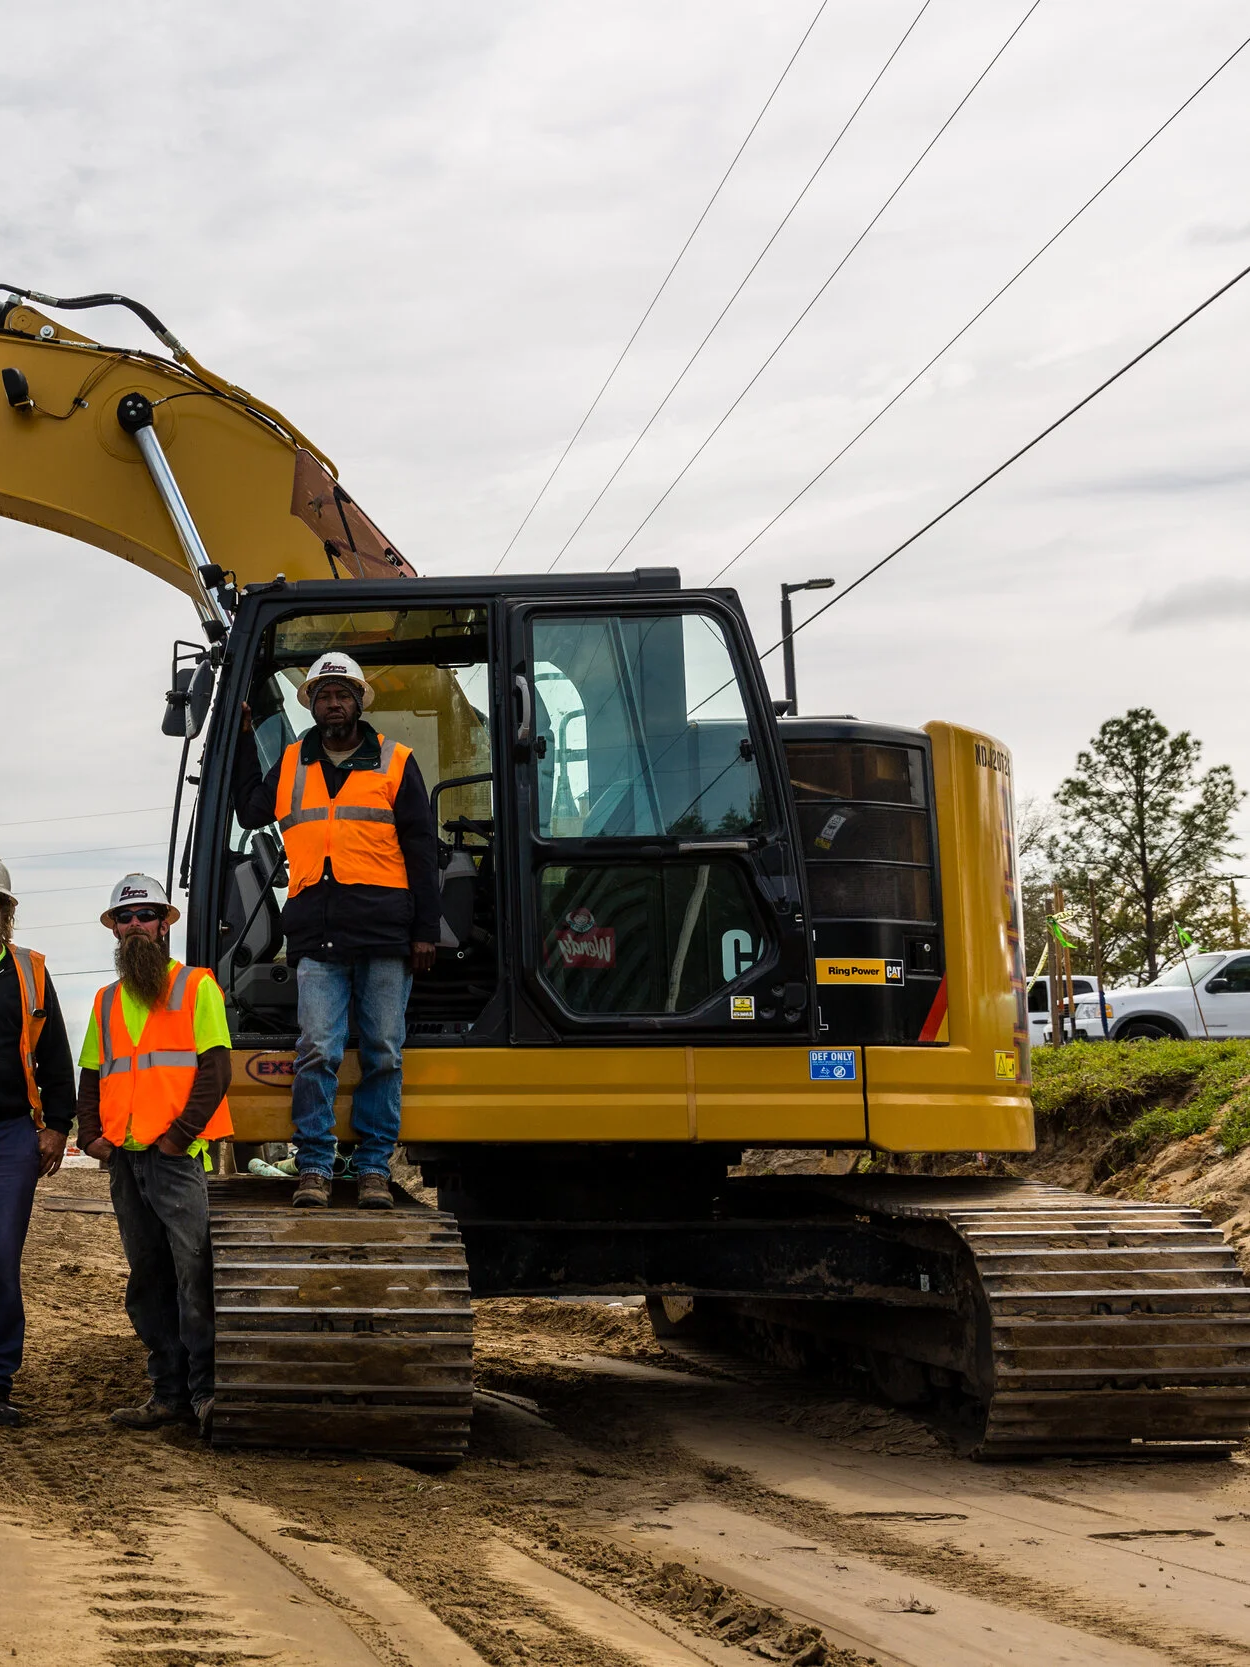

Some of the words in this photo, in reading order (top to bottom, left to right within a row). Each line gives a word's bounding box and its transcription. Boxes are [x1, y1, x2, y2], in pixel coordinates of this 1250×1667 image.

[828, 966, 850, 976] Ring
[851, 966, 880, 975] Power
[886, 965, 902, 979] CAT
[811, 1052, 828, 1061] DEF
[831, 1052, 853, 1061] ONLY
